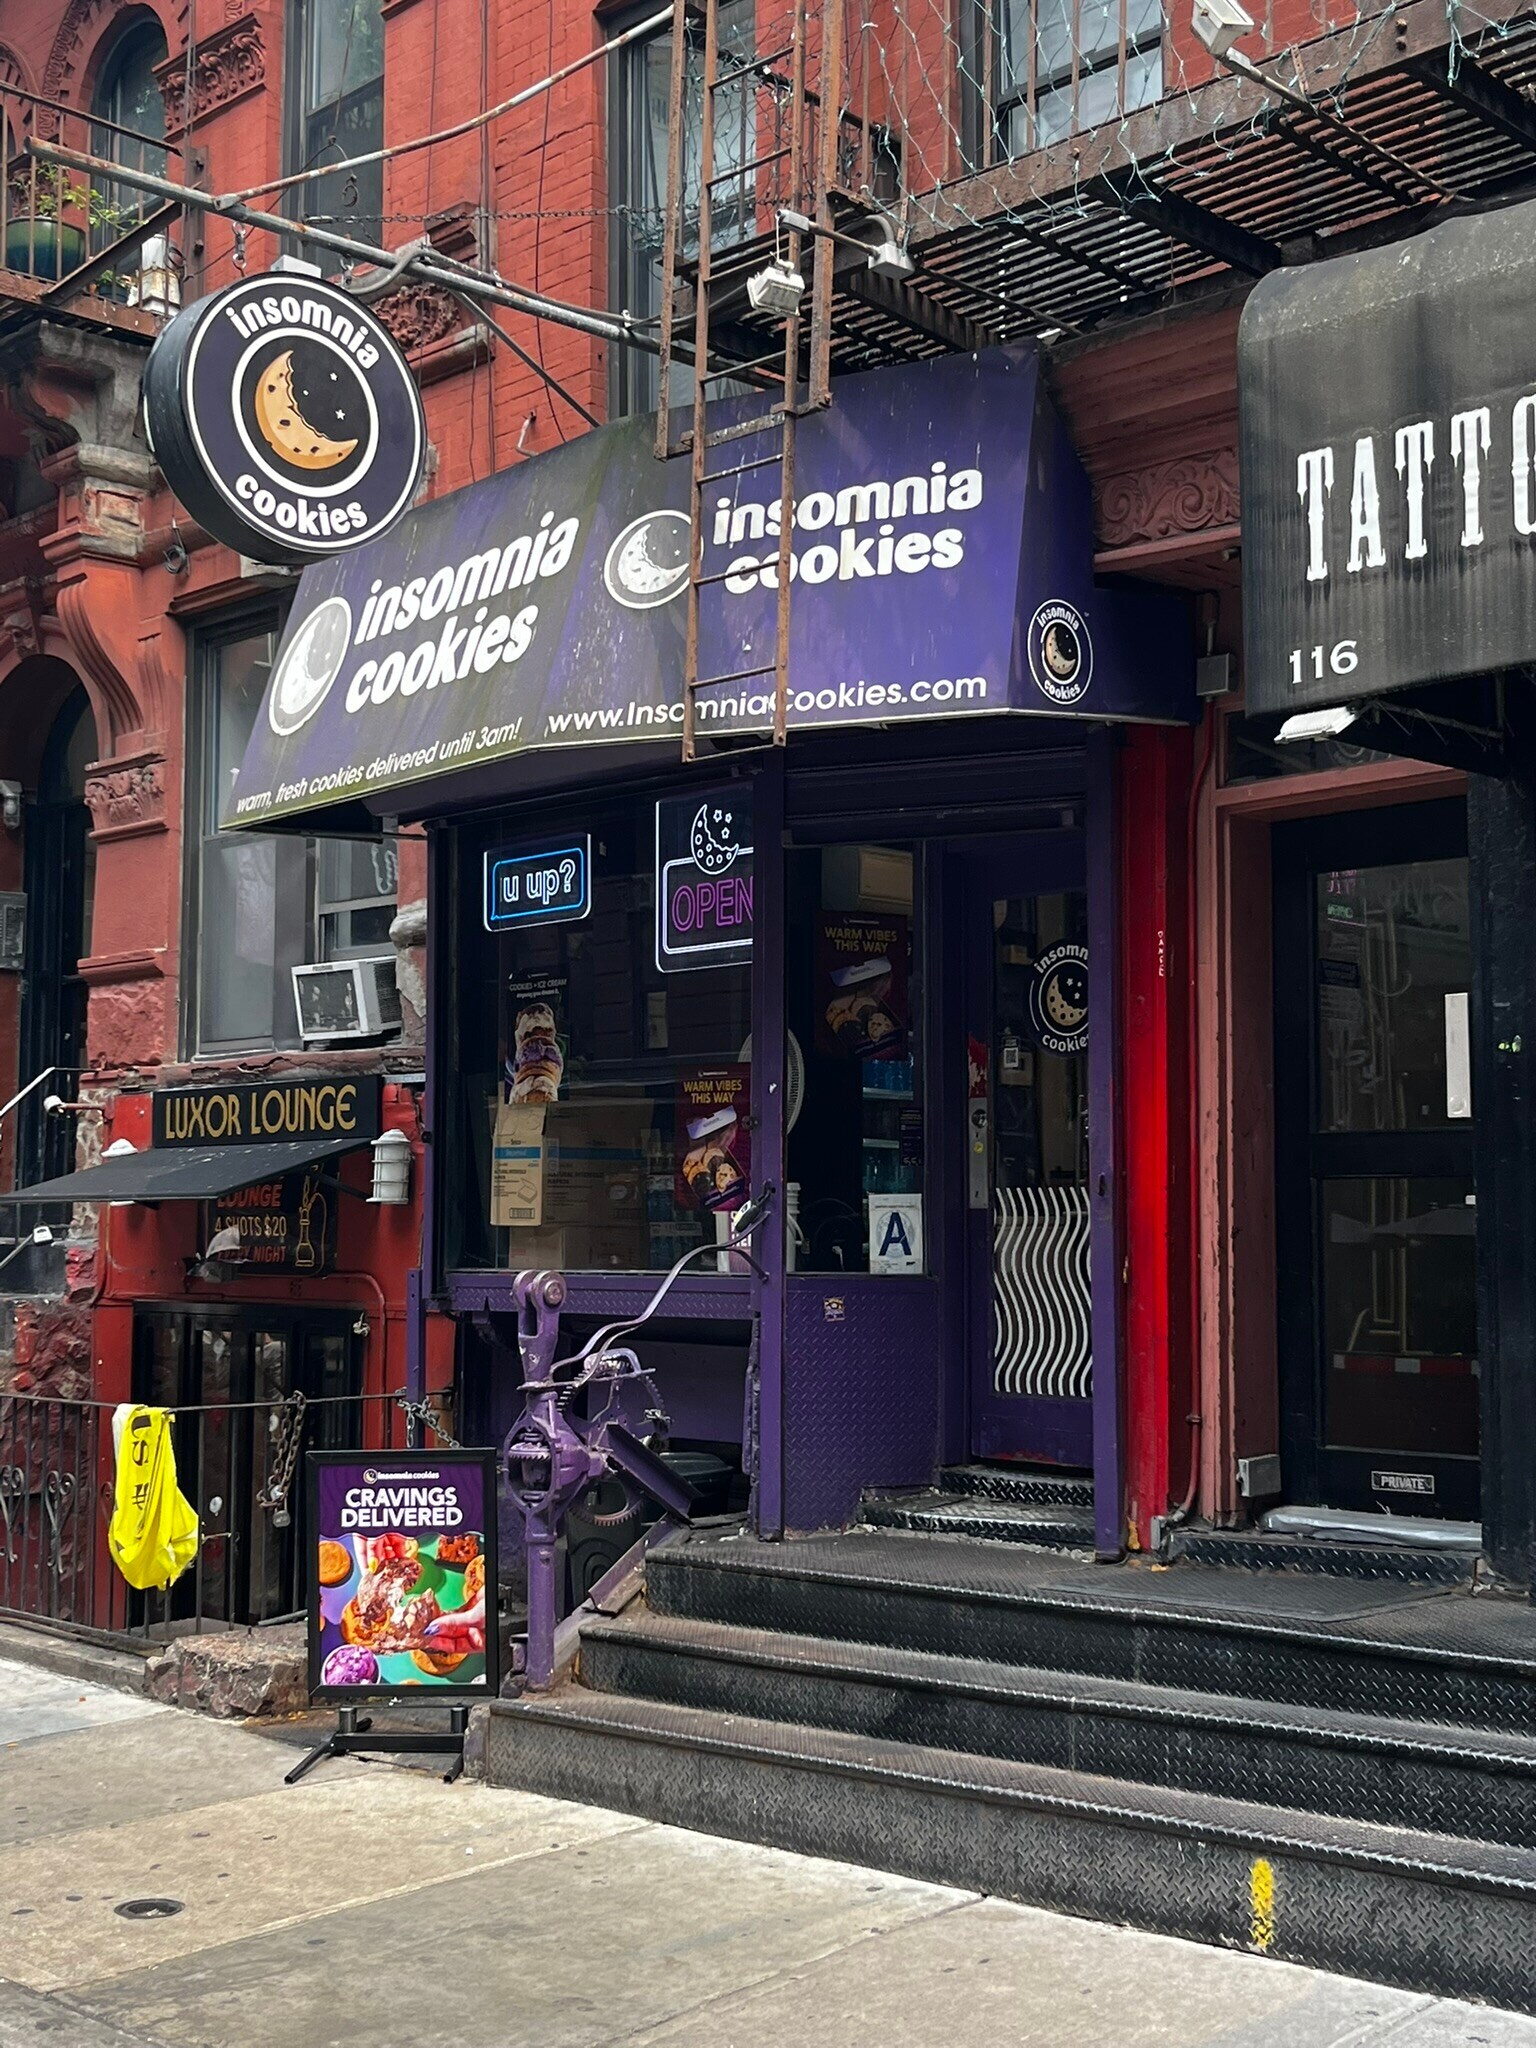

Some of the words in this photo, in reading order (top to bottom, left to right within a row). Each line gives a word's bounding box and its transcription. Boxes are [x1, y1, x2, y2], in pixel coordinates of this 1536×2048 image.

[225, 295, 380, 370] insomnia
[235, 473, 368, 537] cookies
[713, 461, 983, 546] insomnia
[724, 524, 964, 595] cookies
[353, 510, 580, 646] insomnia
[1036, 606, 1080, 631] insomnia
[345, 604, 539, 714] cookies
[1289, 639, 1359, 684] 116
[1043, 679, 1081, 700] cookies
[236, 790, 272, 814] warm,
[275, 781, 309, 804] fresh
[308, 764, 365, 796] cookies
[365, 740, 440, 781] delivered
[438, 733, 476, 761] until
[475, 716, 523, 750] 3am!
[502, 874, 520, 903] u
[526, 858, 577, 906] up?
[671, 875, 753, 932] OPEN
[824, 926, 863, 940] WARM
[865, 928, 898, 943] VIBES
[833, 939, 860, 952] THIS
[862, 940, 889, 953] WAY
[1041, 1034, 1089, 1053] cookie
[683, 1080, 713, 1093] WARM
[715, 1078, 743, 1092] VIBES
[690, 1092, 712, 1105] THIS
[712, 1091, 735, 1104] WAY
[165, 1094, 242, 1139] LUXOR
[250, 1083, 358, 1135] LOUNGE
[214, 1216, 222, 1233] 4
[264, 1213, 287, 1239] $20
[878, 1211, 913, 1257] A
[253, 1245, 286, 1263] NIGHT
[345, 1486, 458, 1508] CRAVINGS
[1380, 1475, 1425, 1490] PRIVATE
[341, 1506, 463, 1528] DELIVERED
